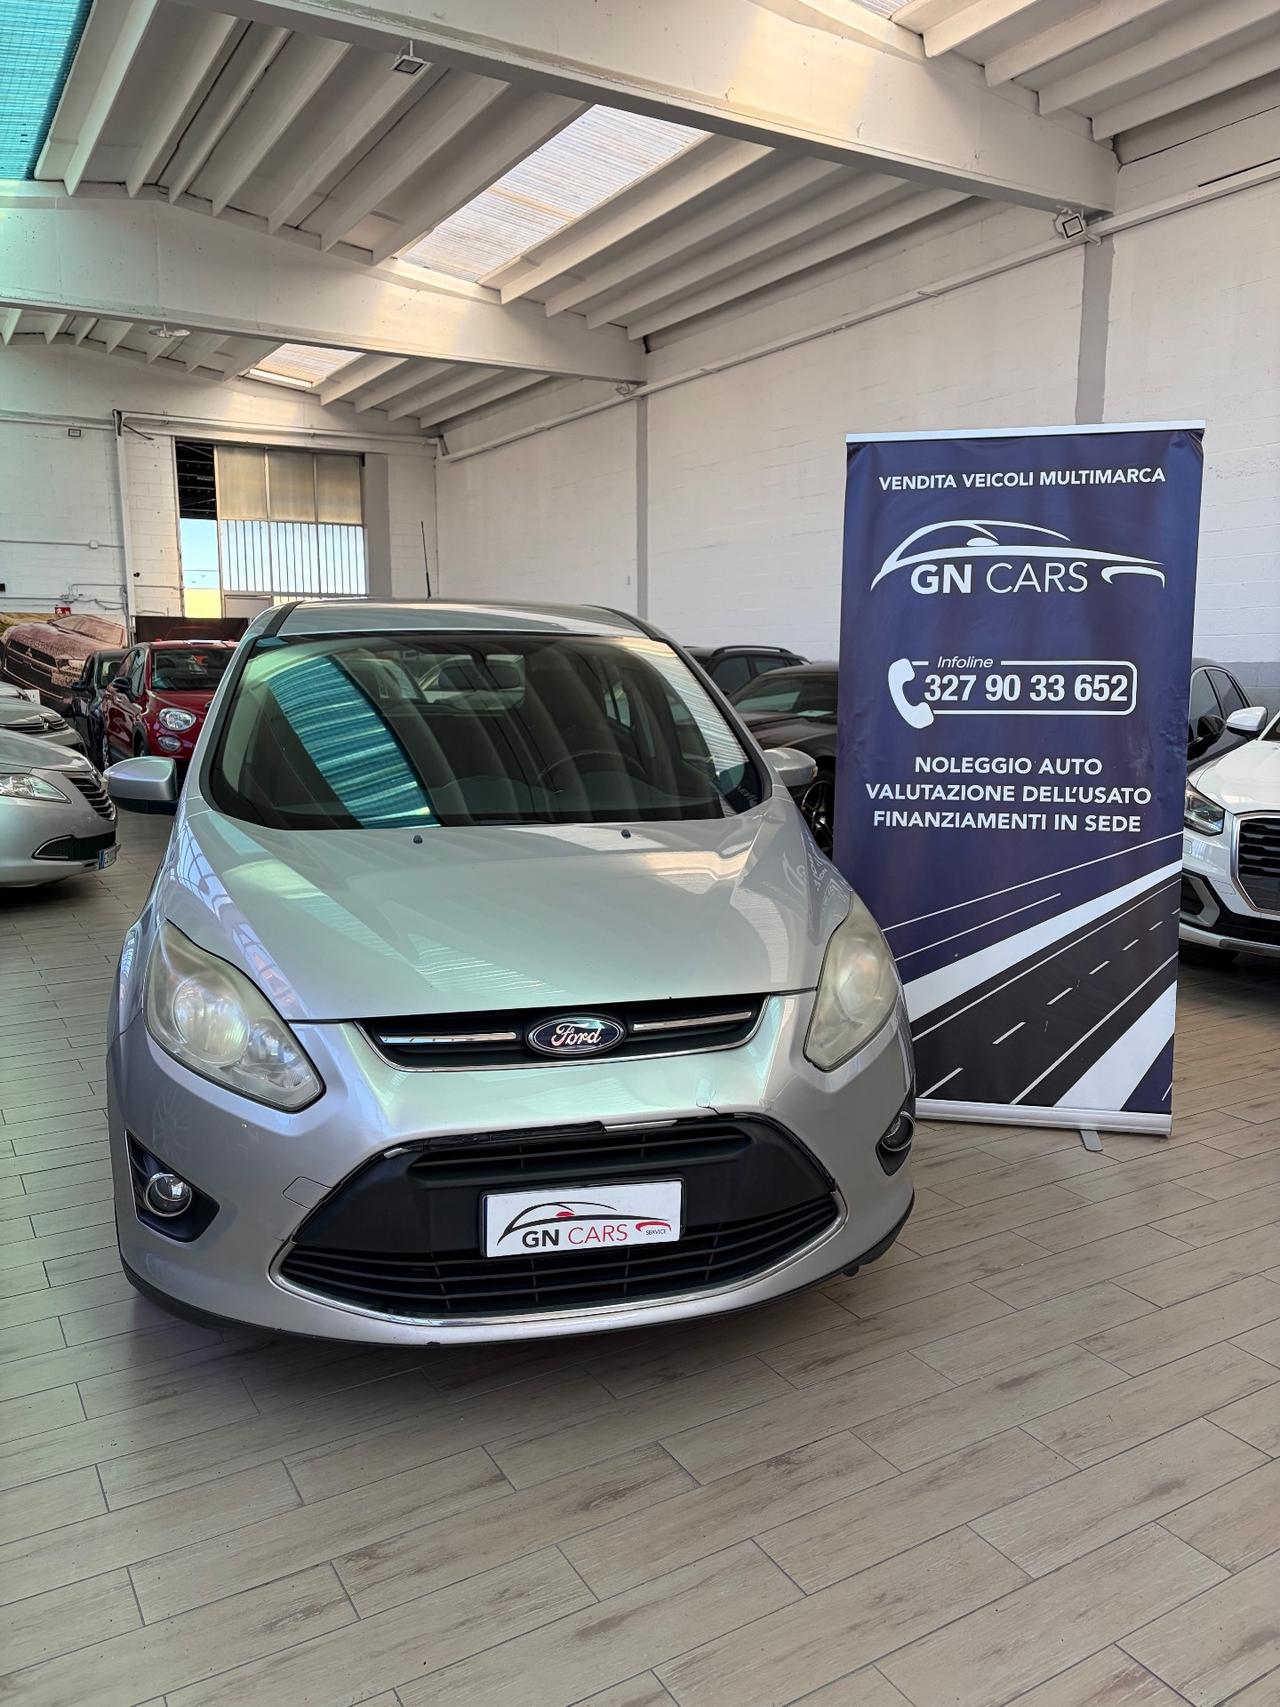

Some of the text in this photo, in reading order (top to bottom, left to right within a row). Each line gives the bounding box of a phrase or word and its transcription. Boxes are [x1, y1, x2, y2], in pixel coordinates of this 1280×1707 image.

[879, 468, 1166, 490] VENDITA VEICOLI MULTIMARCA
[910, 561, 1088, 594] GN CARS
[937, 656, 993, 669] Infoline
[924, 674, 1128, 702] 327 90 33 652
[914, 756, 1103, 776] NOLEGGIO AUTO
[866, 783, 1152, 805] VALUTAZIONE DELL'USATO
[873, 810, 1142, 833] FINANZIAMENTI IN SEDE
[551, 1022, 606, 1046] Ford
[521, 1223, 628, 1248] GN CARS
